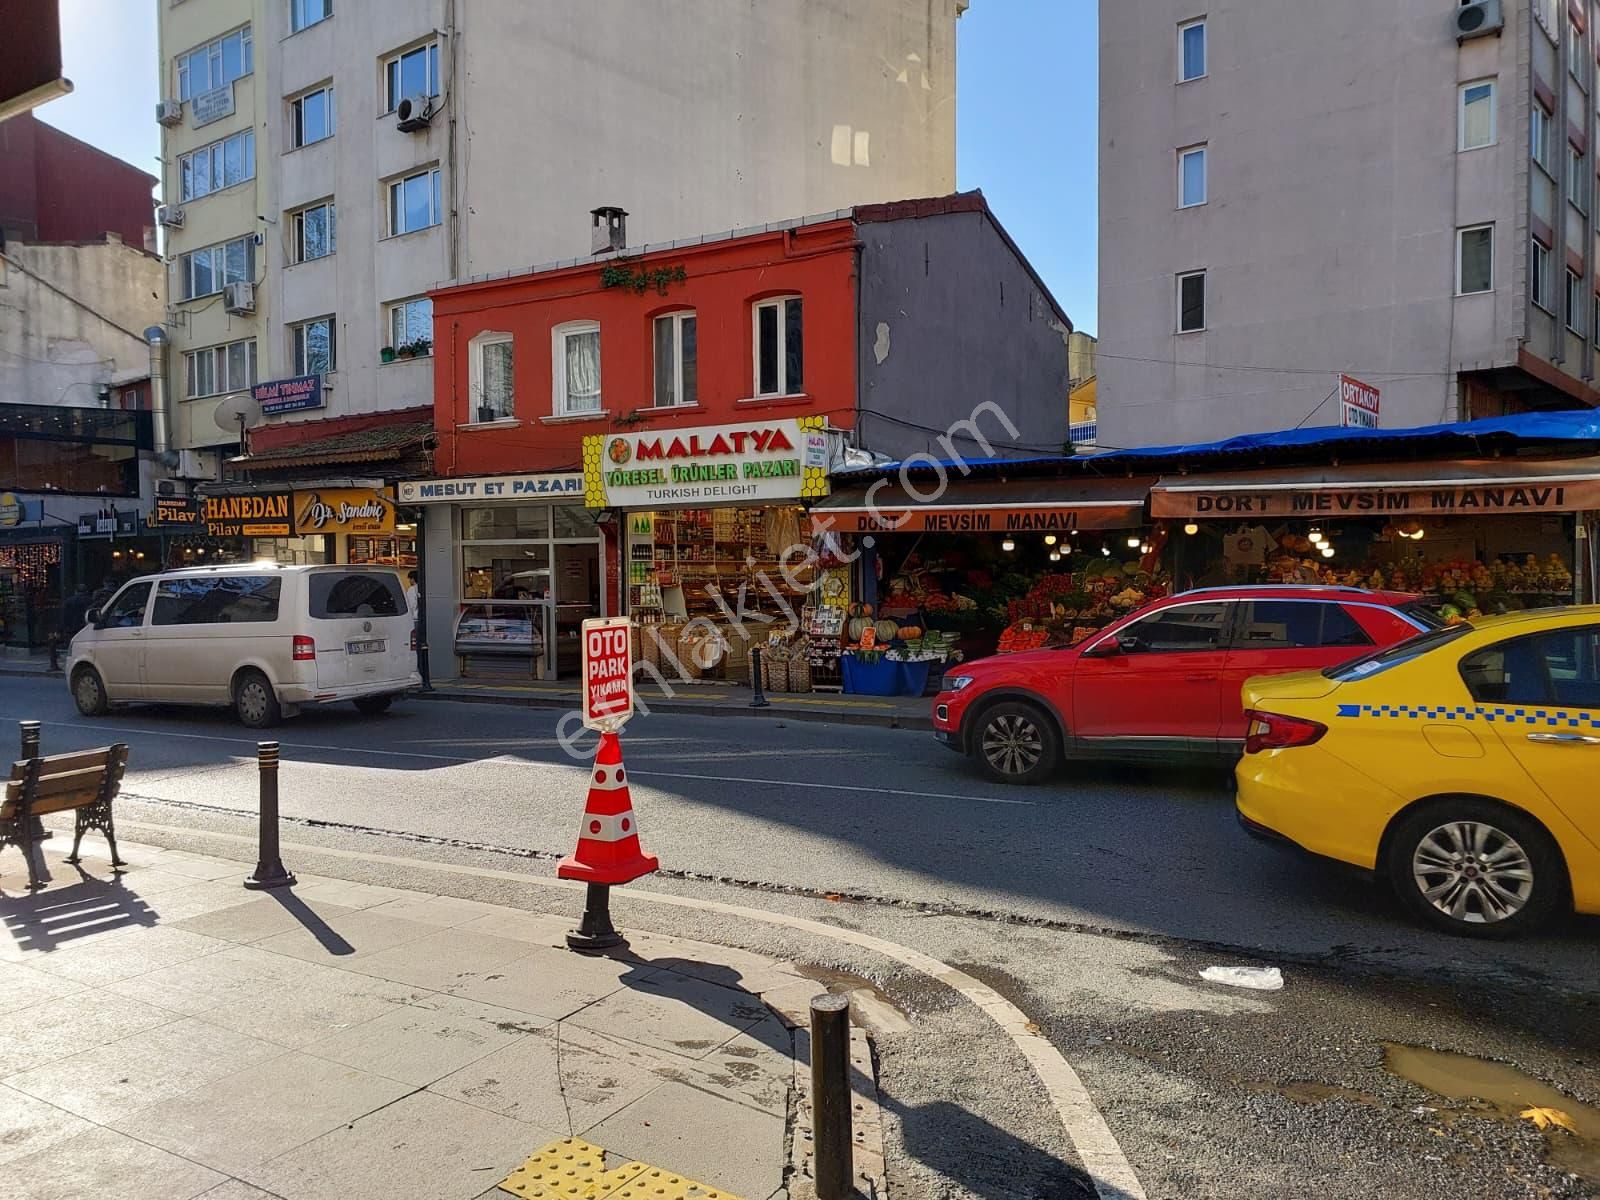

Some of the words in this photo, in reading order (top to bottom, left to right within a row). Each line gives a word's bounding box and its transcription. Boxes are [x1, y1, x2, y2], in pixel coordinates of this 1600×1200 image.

[635, 428, 795, 460] MALATYA
[605, 467, 666, 487] YÖRESEL
[671, 463, 737, 483] ÜRÜNLER
[743, 459, 800, 479] PAZARI
[420, 482, 477, 497] MESUT
[484, 482, 504, 495] ET
[512, 478, 583, 493] PAZARI
[647, 488, 700, 499] TURKISH
[704, 485, 758, 496] DELIGHT
[207, 495, 289, 519] HANEDAN
[1292, 489, 1410, 511] MEVSİM
[1431, 487, 1565, 508] MANAVI
[158, 508, 197, 522] Pilav
[924, 510, 991, 531] MEVSİM
[1006, 512, 1078, 530] MANAVI
[208, 522, 241, 536] Pilav
[588, 629, 626, 658] OTO
[589, 656, 626, 681] PARK
[590, 680, 628, 697] YIKAMA
